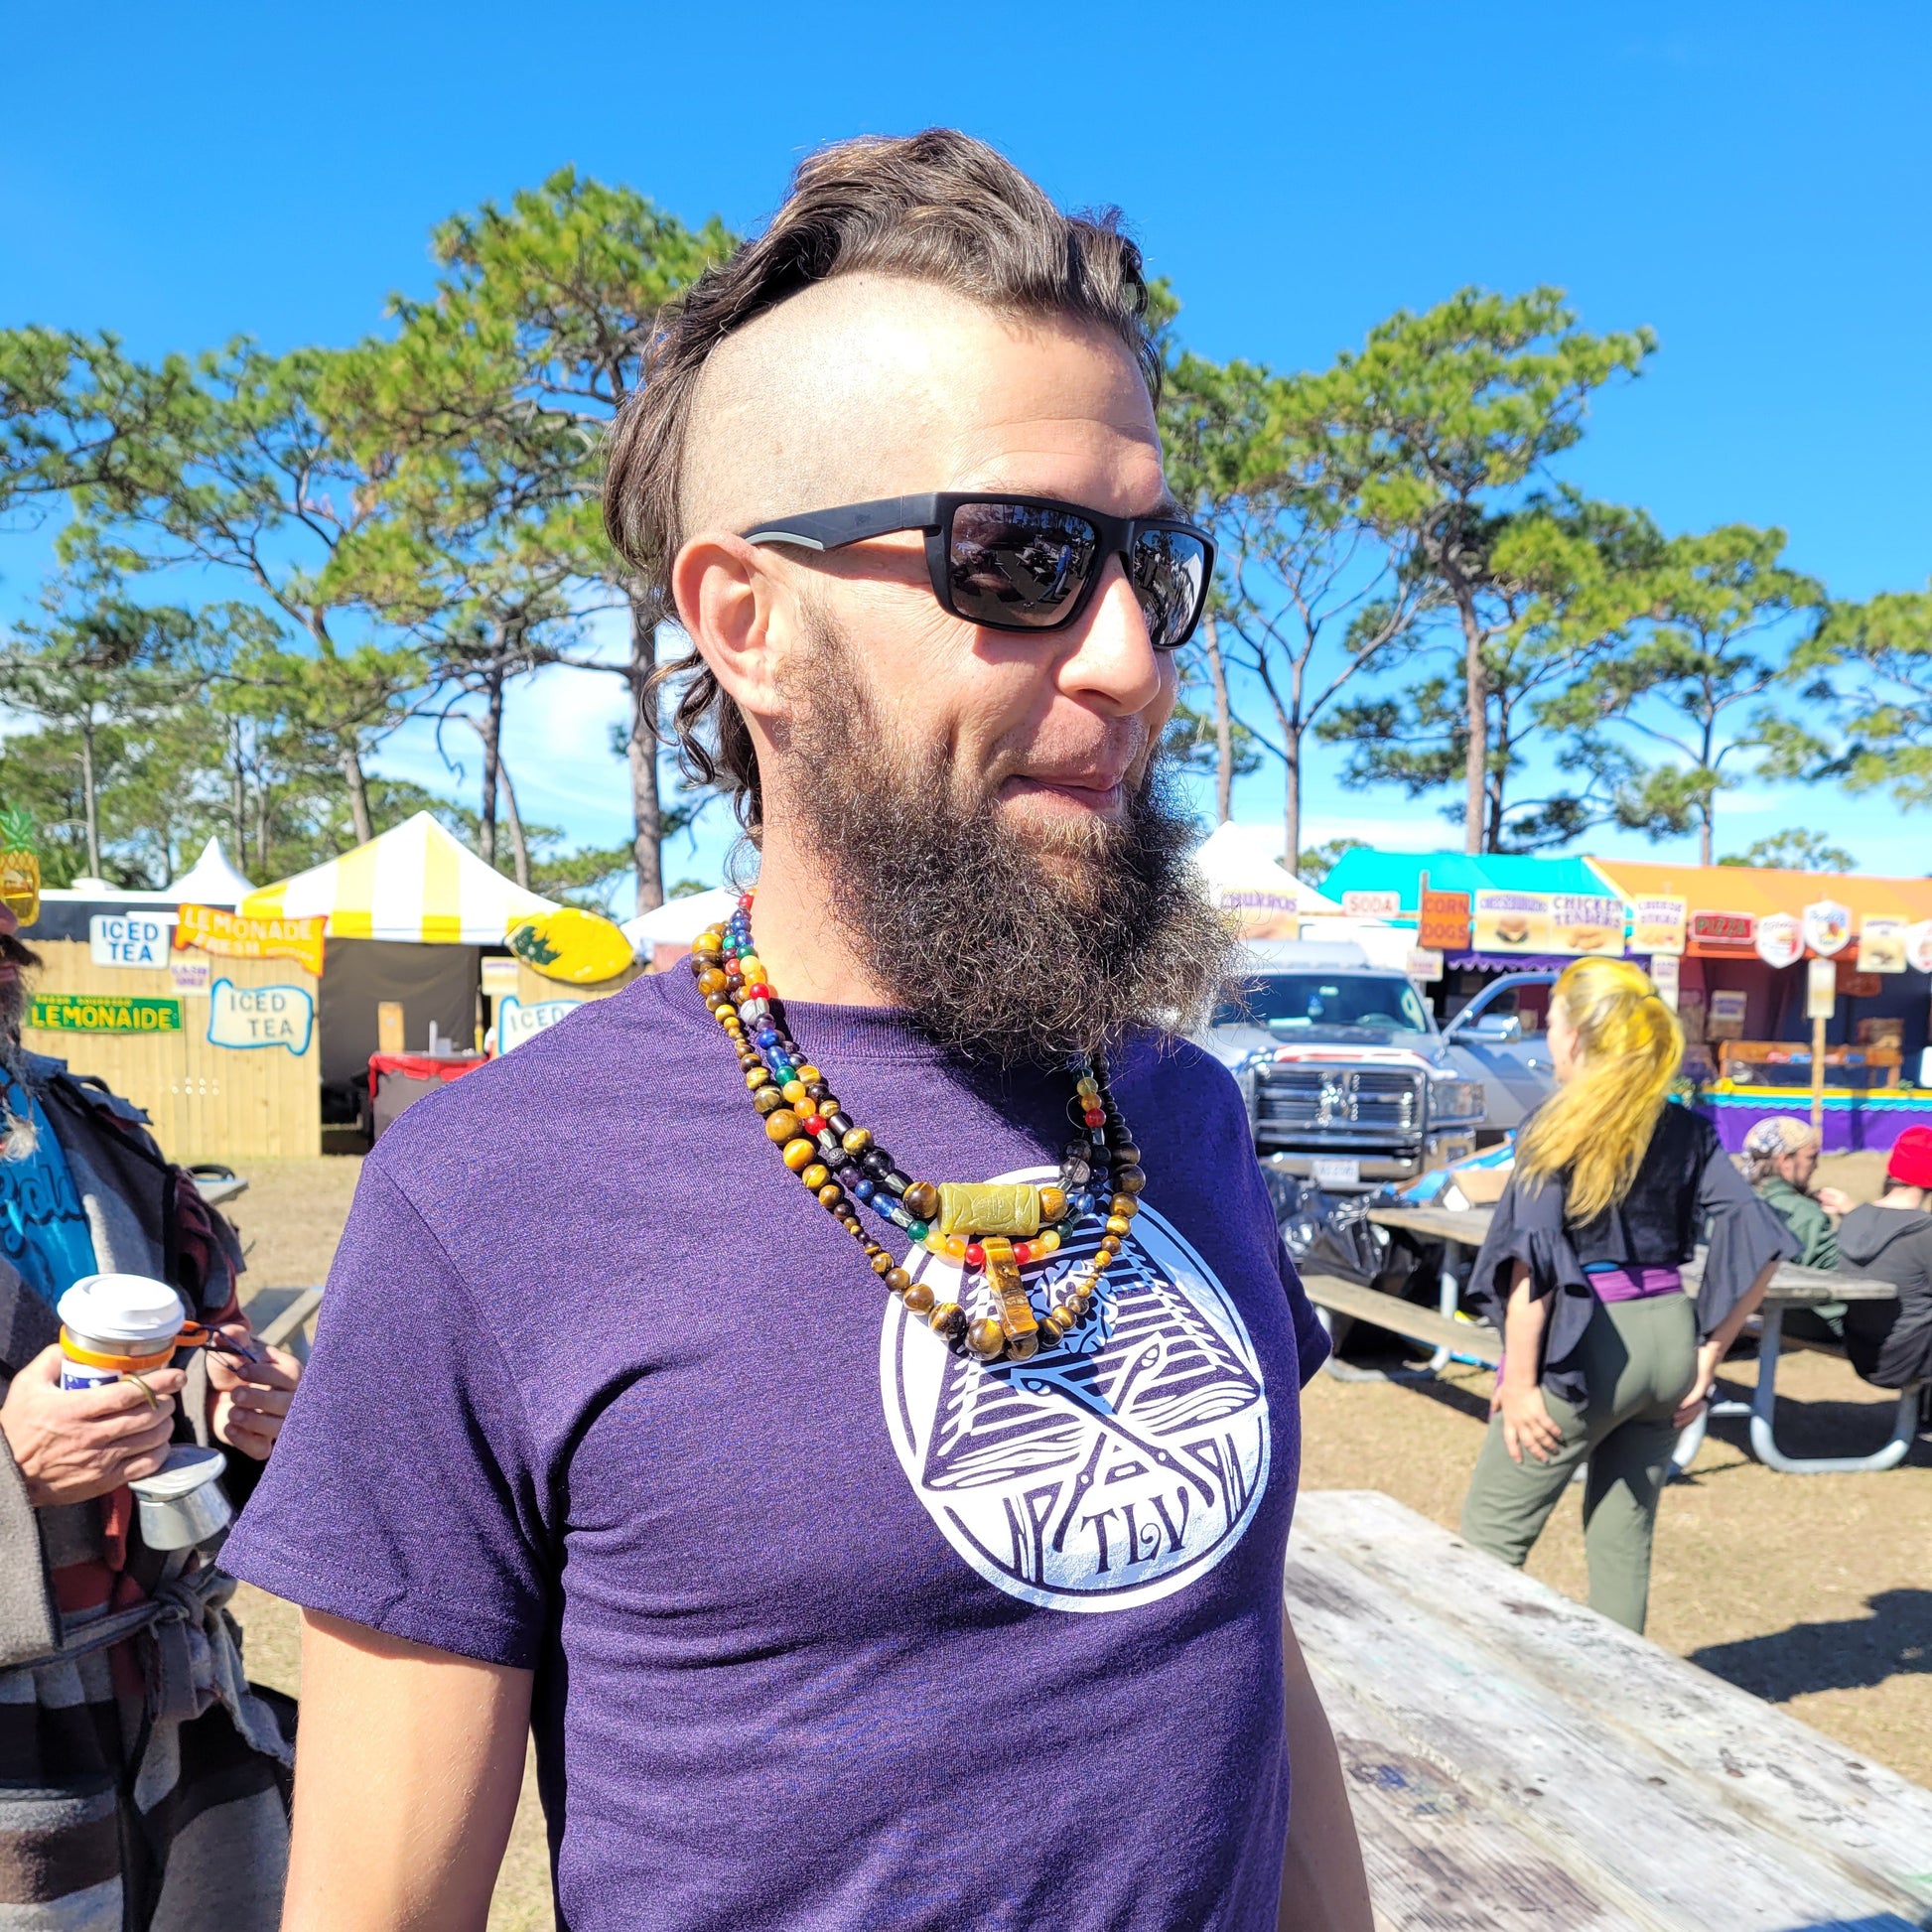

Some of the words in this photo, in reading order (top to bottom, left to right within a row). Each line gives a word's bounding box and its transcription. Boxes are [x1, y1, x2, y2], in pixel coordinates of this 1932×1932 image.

[1349, 896, 1394, 913] SODA
[1423, 897, 1469, 915] CORN
[1553, 896, 1624, 912] CHICKEN
[101, 920, 159, 940] ICED
[184, 906, 314, 941] LEMONADE
[1422, 922, 1469, 940] DOGS
[1554, 912, 1621, 930] TENDERS
[1696, 916, 1747, 937] PIZZA
[108, 943, 153, 962] TEA
[229, 993, 286, 1013] ICED
[31, 1005, 174, 1030] LEMONAIDE
[509, 1005, 566, 1033] ICED
[248, 1018, 295, 1038] TEA
[1079, 1485, 1189, 1576] TLV
